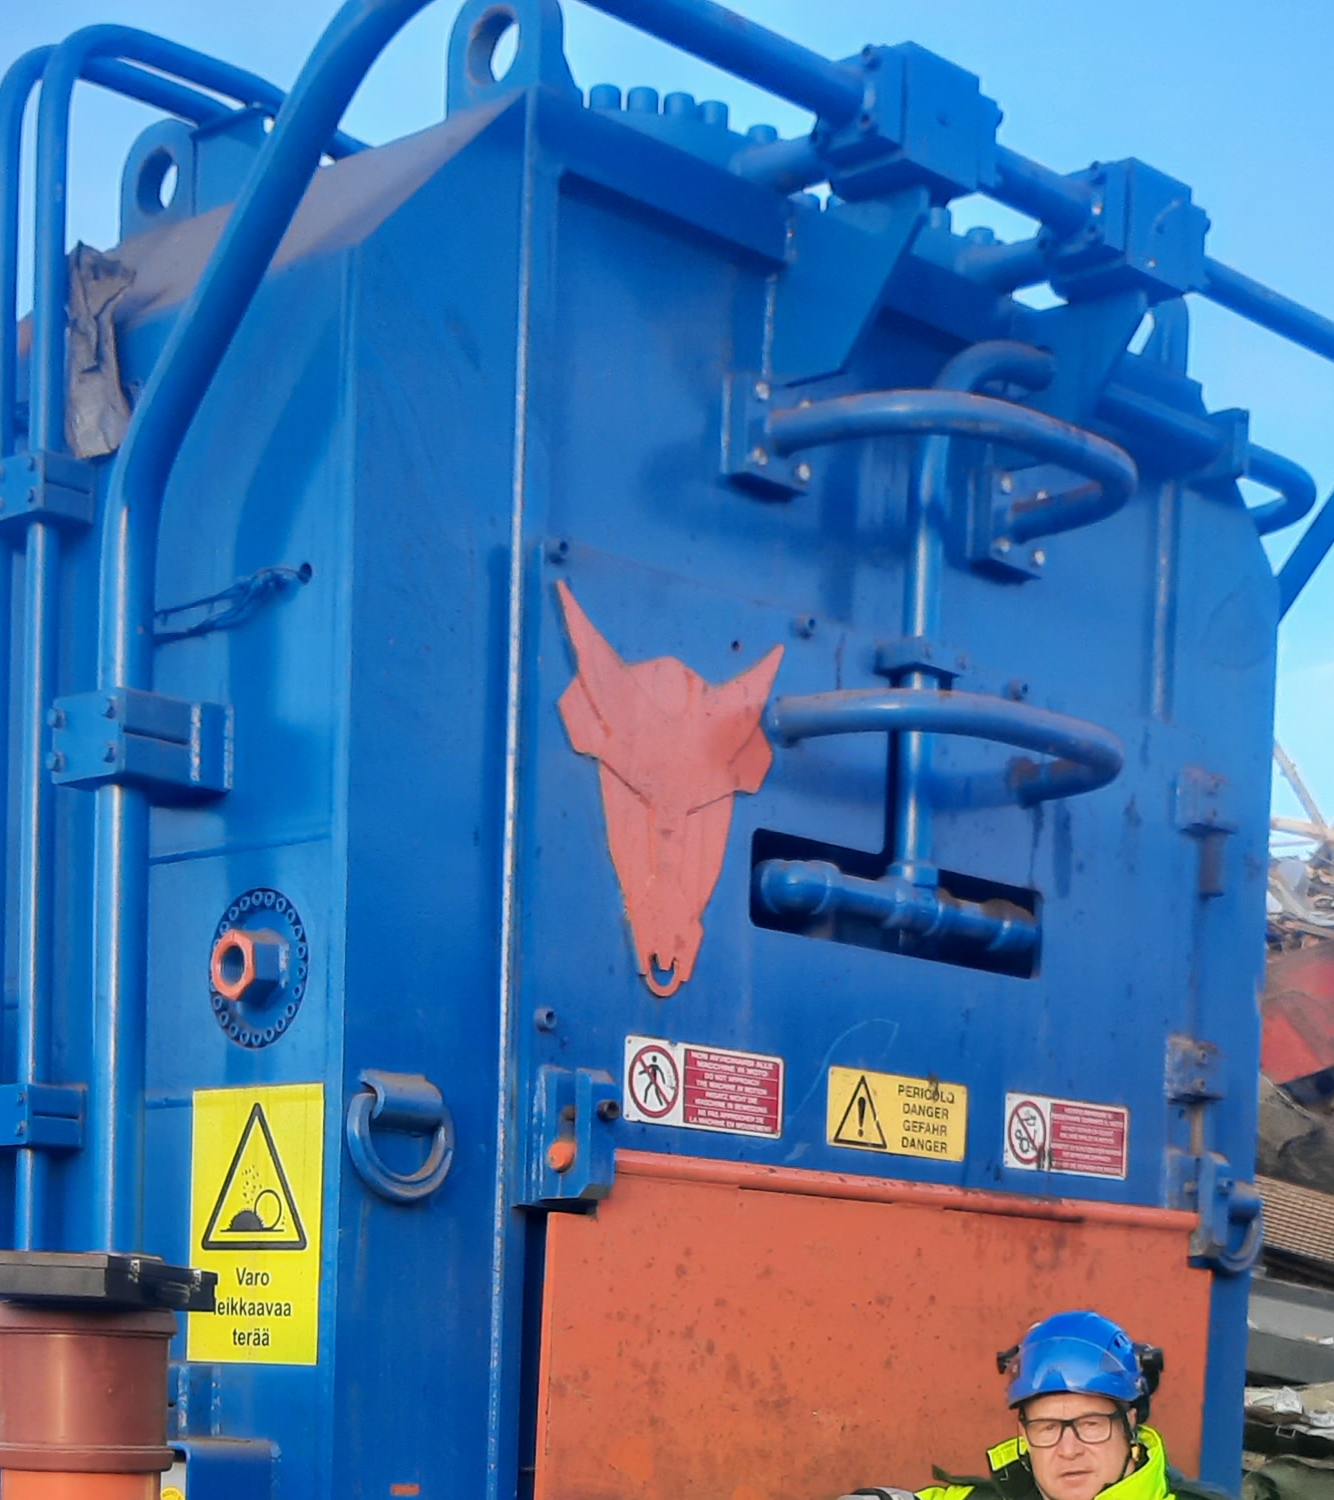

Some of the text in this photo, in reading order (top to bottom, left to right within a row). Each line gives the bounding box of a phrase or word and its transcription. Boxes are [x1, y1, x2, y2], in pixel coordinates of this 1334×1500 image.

[902, 1103, 949, 1120] DANGER
[902, 1119, 948, 1137] GEFAHR
[901, 1136, 948, 1154] DANGER
[236, 1267, 270, 1286] Varo
[213, 1297, 292, 1317] eikkaavaa
[232, 1328, 270, 1346] terää
